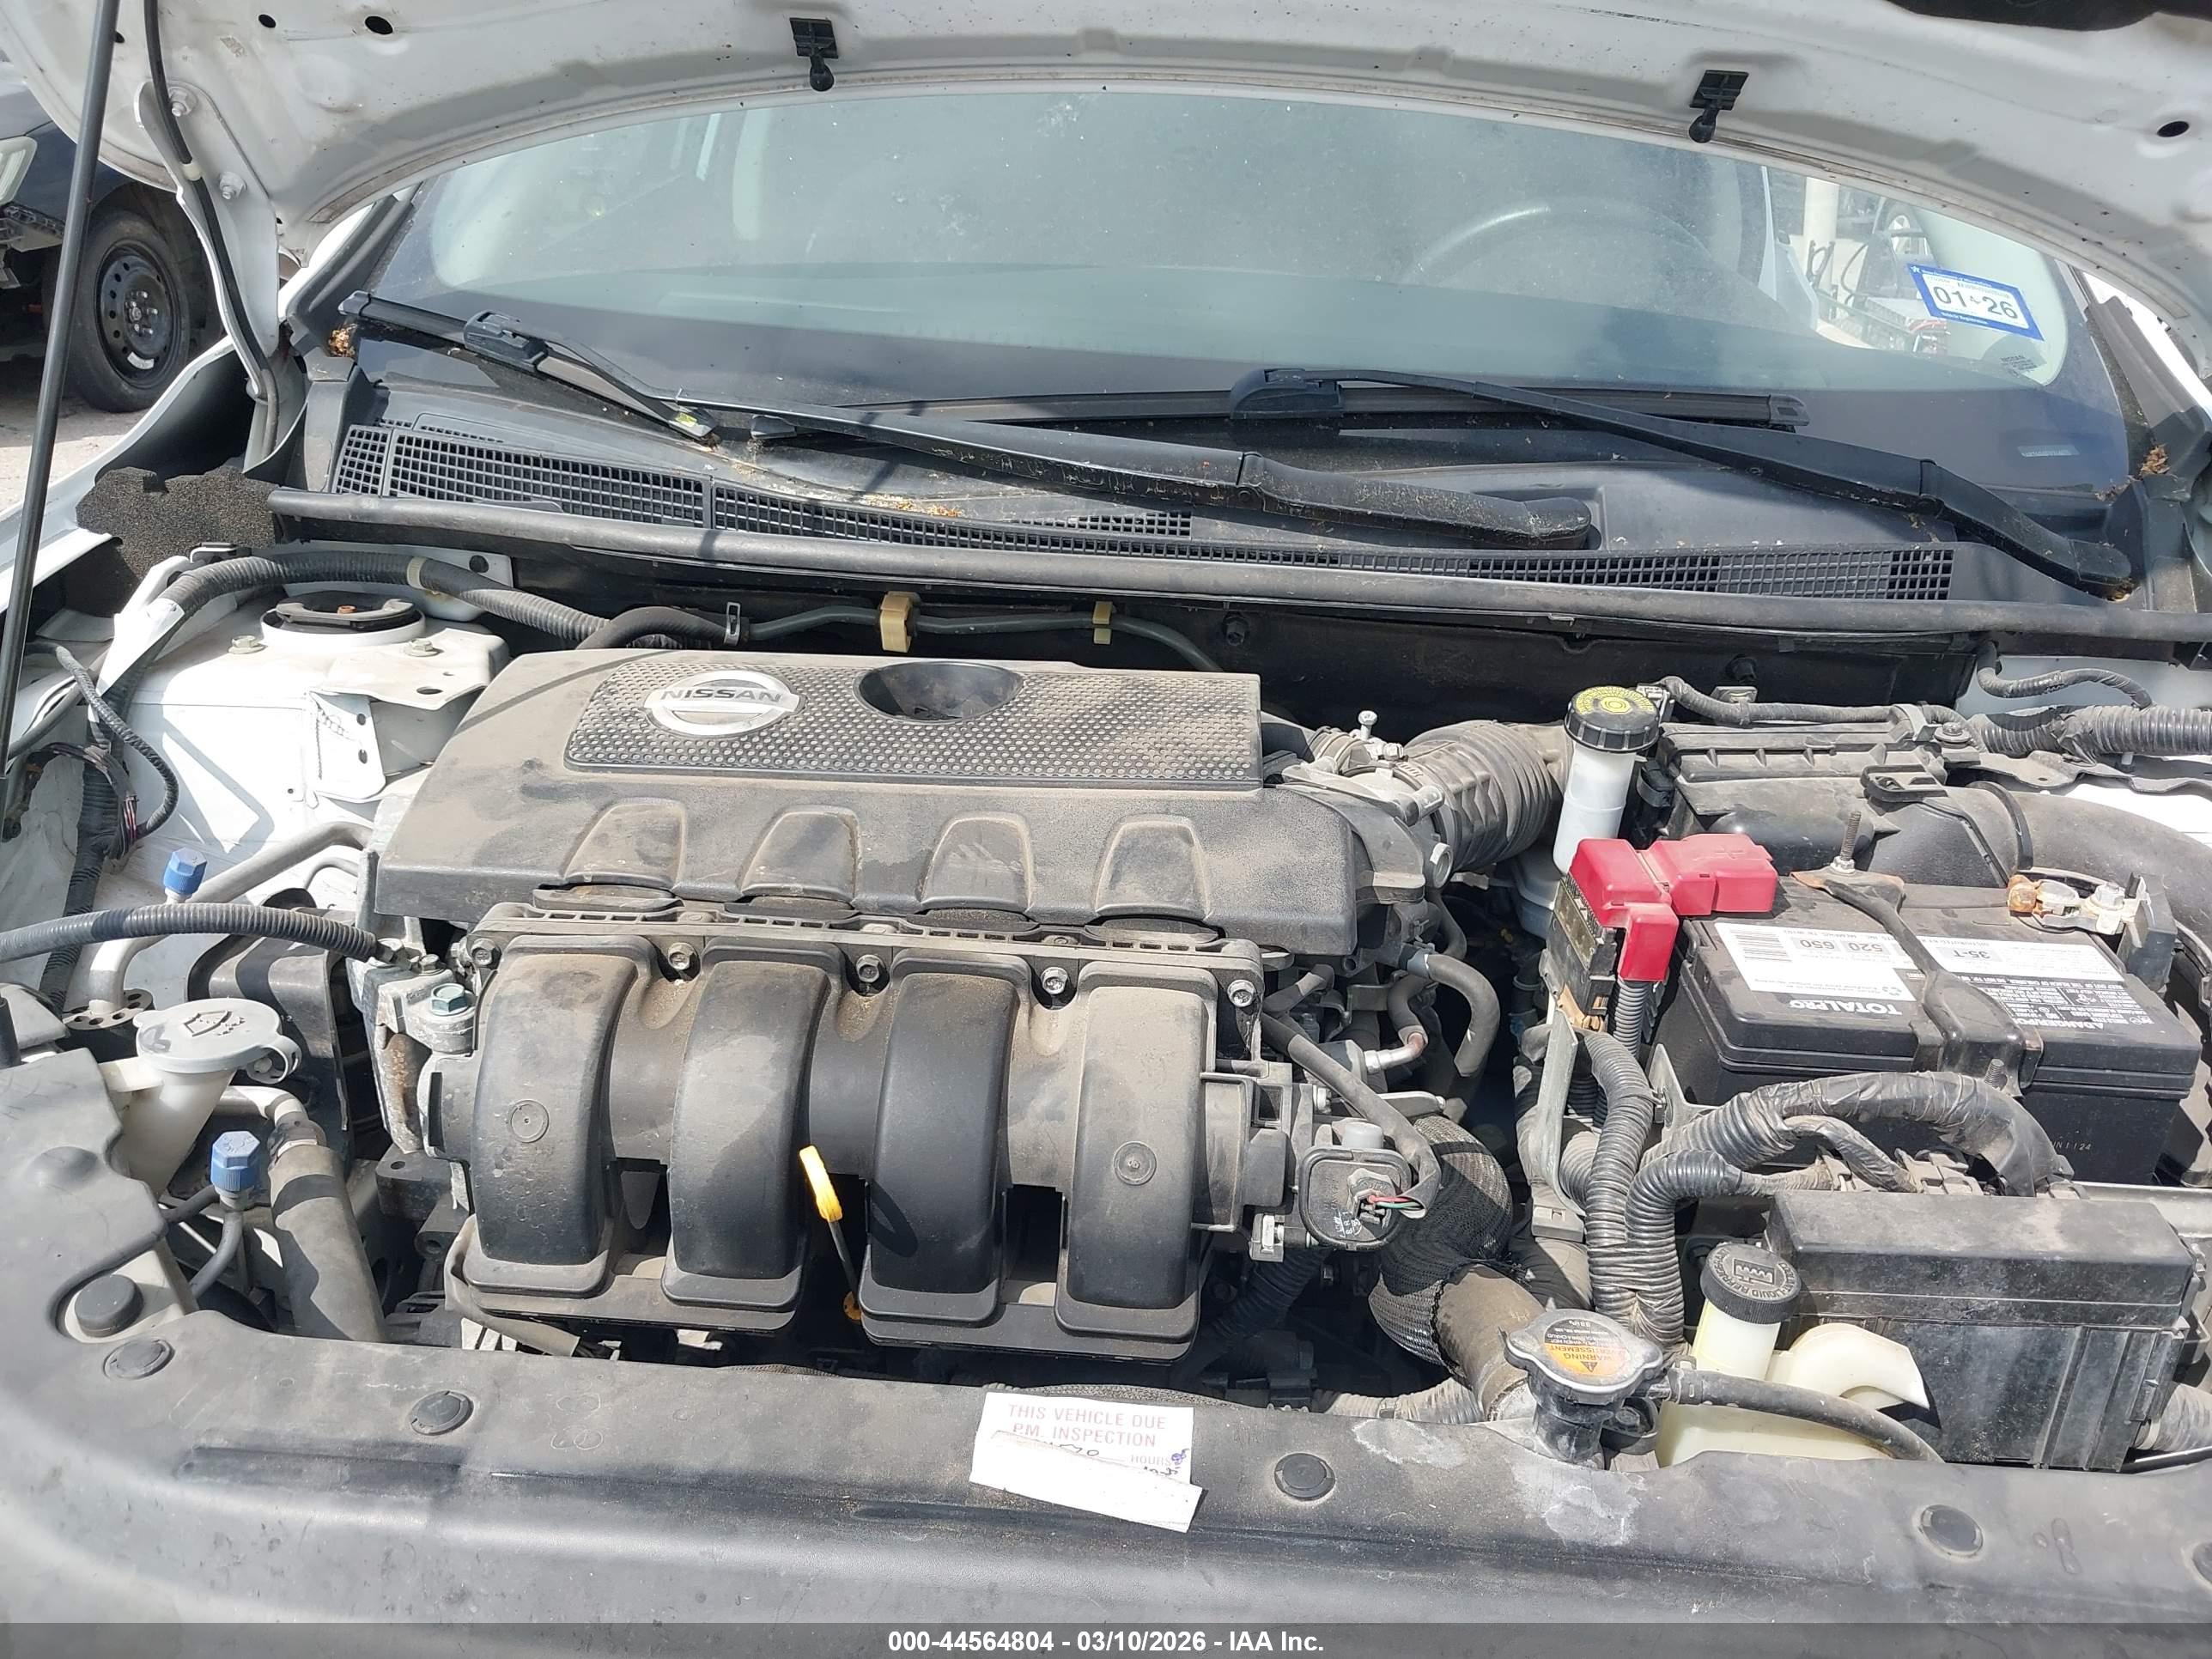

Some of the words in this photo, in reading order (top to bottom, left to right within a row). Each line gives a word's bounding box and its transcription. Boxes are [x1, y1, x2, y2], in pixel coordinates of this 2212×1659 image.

[1934, 286, 1967, 307] 01
[1983, 296, 2018, 319] 26
[661, 689, 782, 702] NISSAN
[1800, 939, 1835, 951] 650
[1848, 941, 1883, 953] 520
[1953, 949, 1990, 959] 35-T
[1790, 1000, 1902, 1016] TOTALPRO
[1008, 1404, 1046, 1419] THIS
[1054, 1407, 1124, 1426] VEHICLE
[1132, 1414, 1167, 1430] DUE
[1053, 1426, 1157, 1448] INSPECTION
[1131, 1454, 1172, 1467] HOURS
